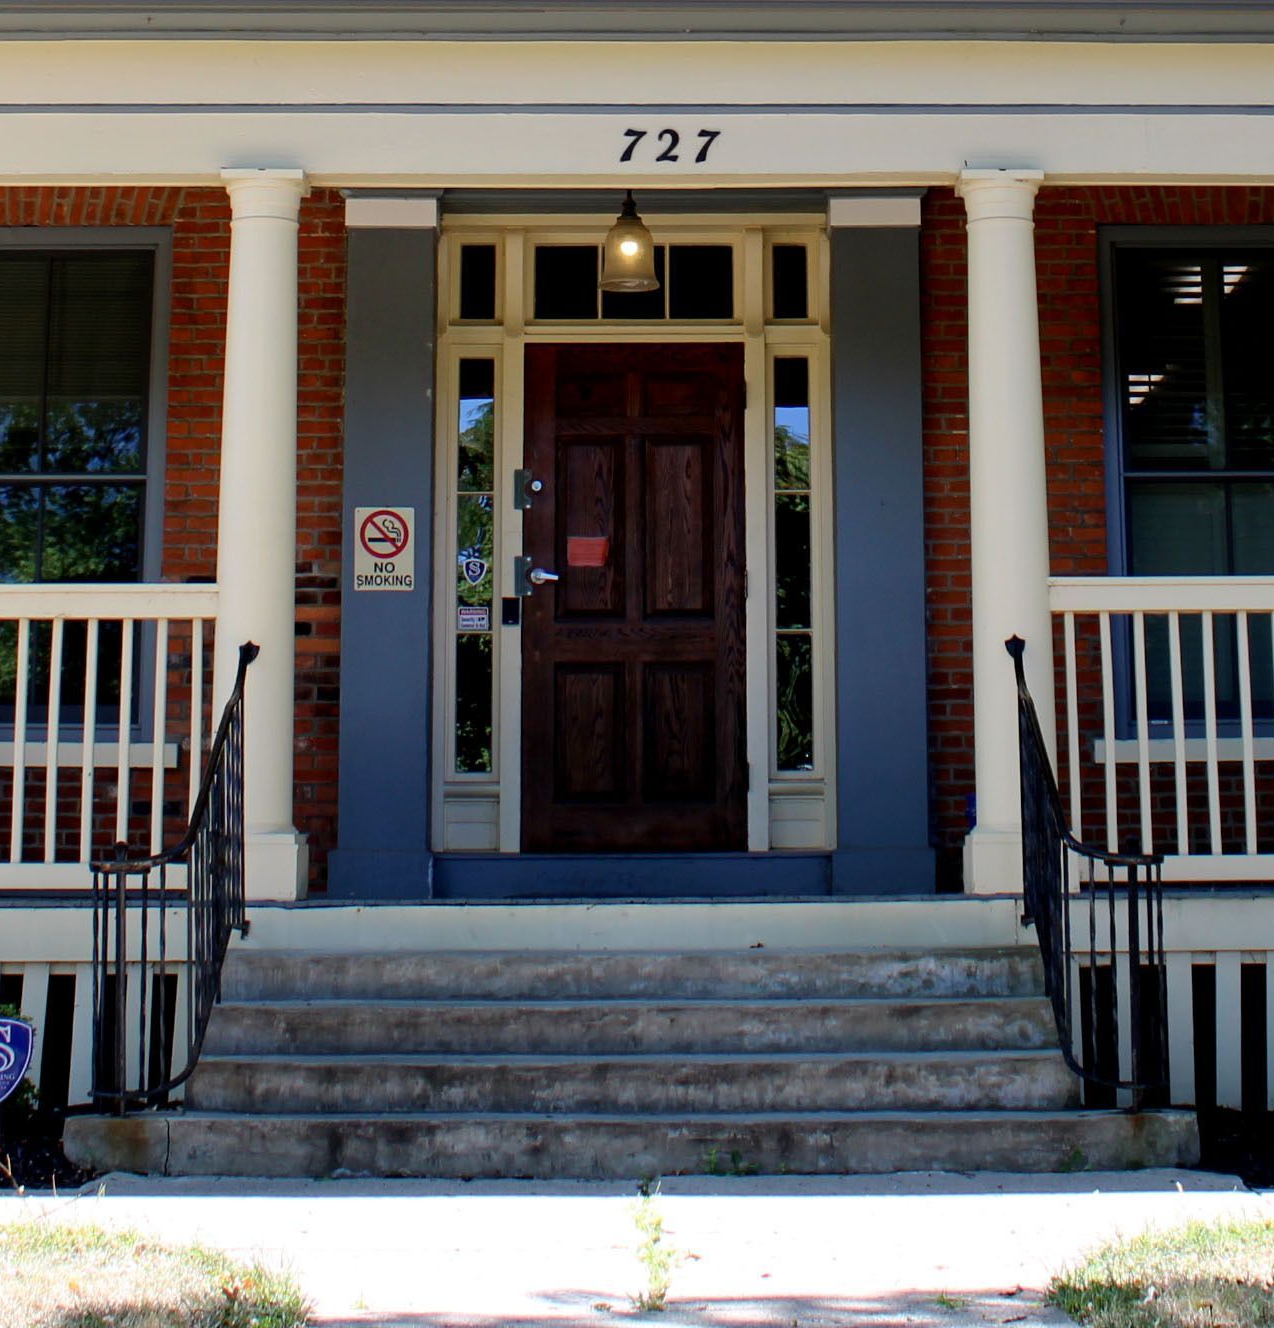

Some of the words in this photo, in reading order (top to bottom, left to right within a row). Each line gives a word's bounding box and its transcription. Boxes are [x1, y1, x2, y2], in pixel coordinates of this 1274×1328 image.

[620, 128, 721, 163] 727
[374, 562, 395, 573] NO
[469, 562, 481, 576] S
[356, 574, 412, 587] SMOKING
